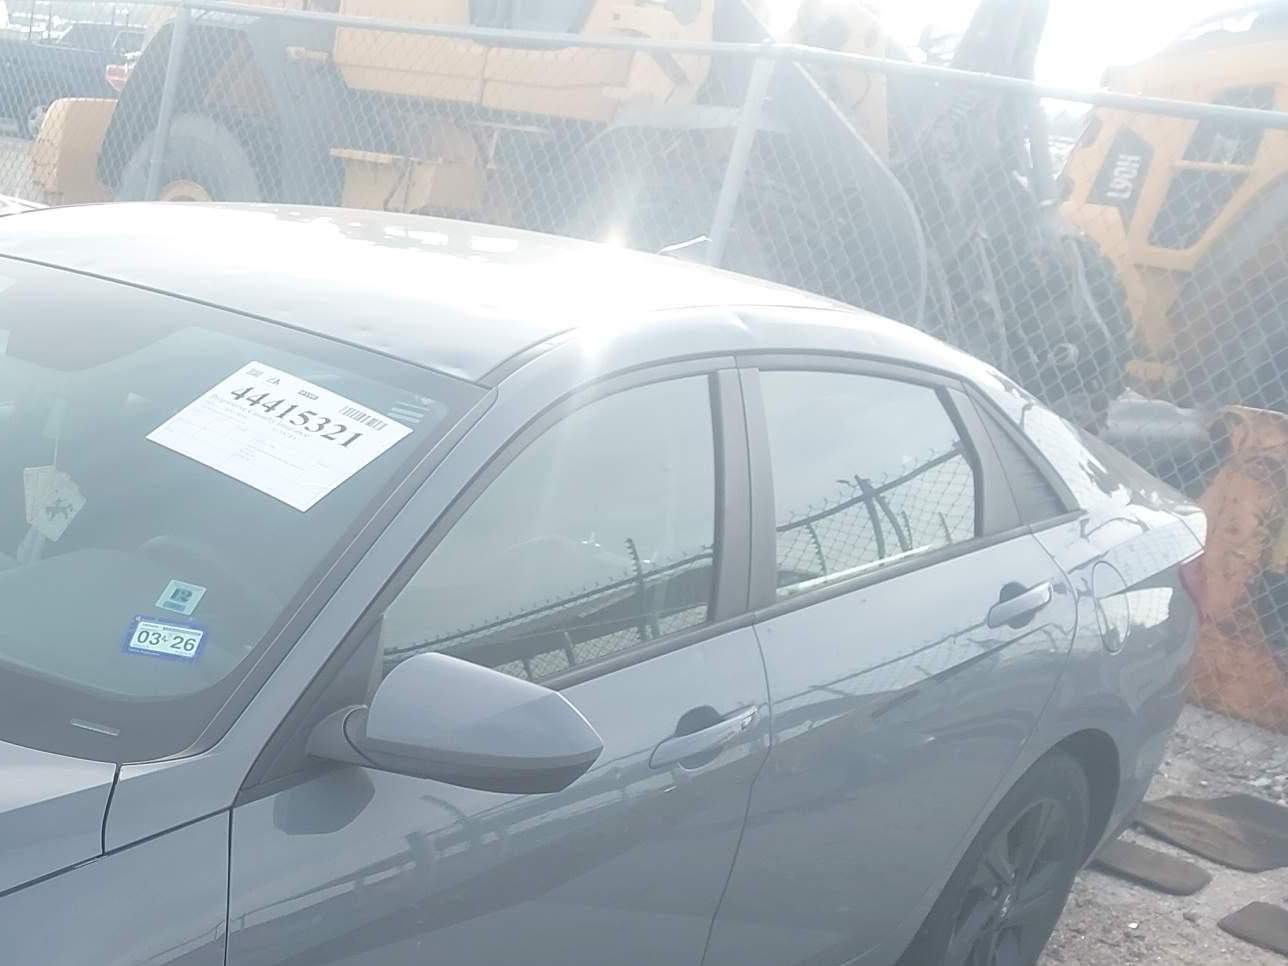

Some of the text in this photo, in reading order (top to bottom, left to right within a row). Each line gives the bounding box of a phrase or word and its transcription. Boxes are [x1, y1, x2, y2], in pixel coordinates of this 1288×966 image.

[1106, 154, 1142, 200] L90H
[230, 386, 363, 448] 44415321
[137, 630, 197, 652] 03 26
